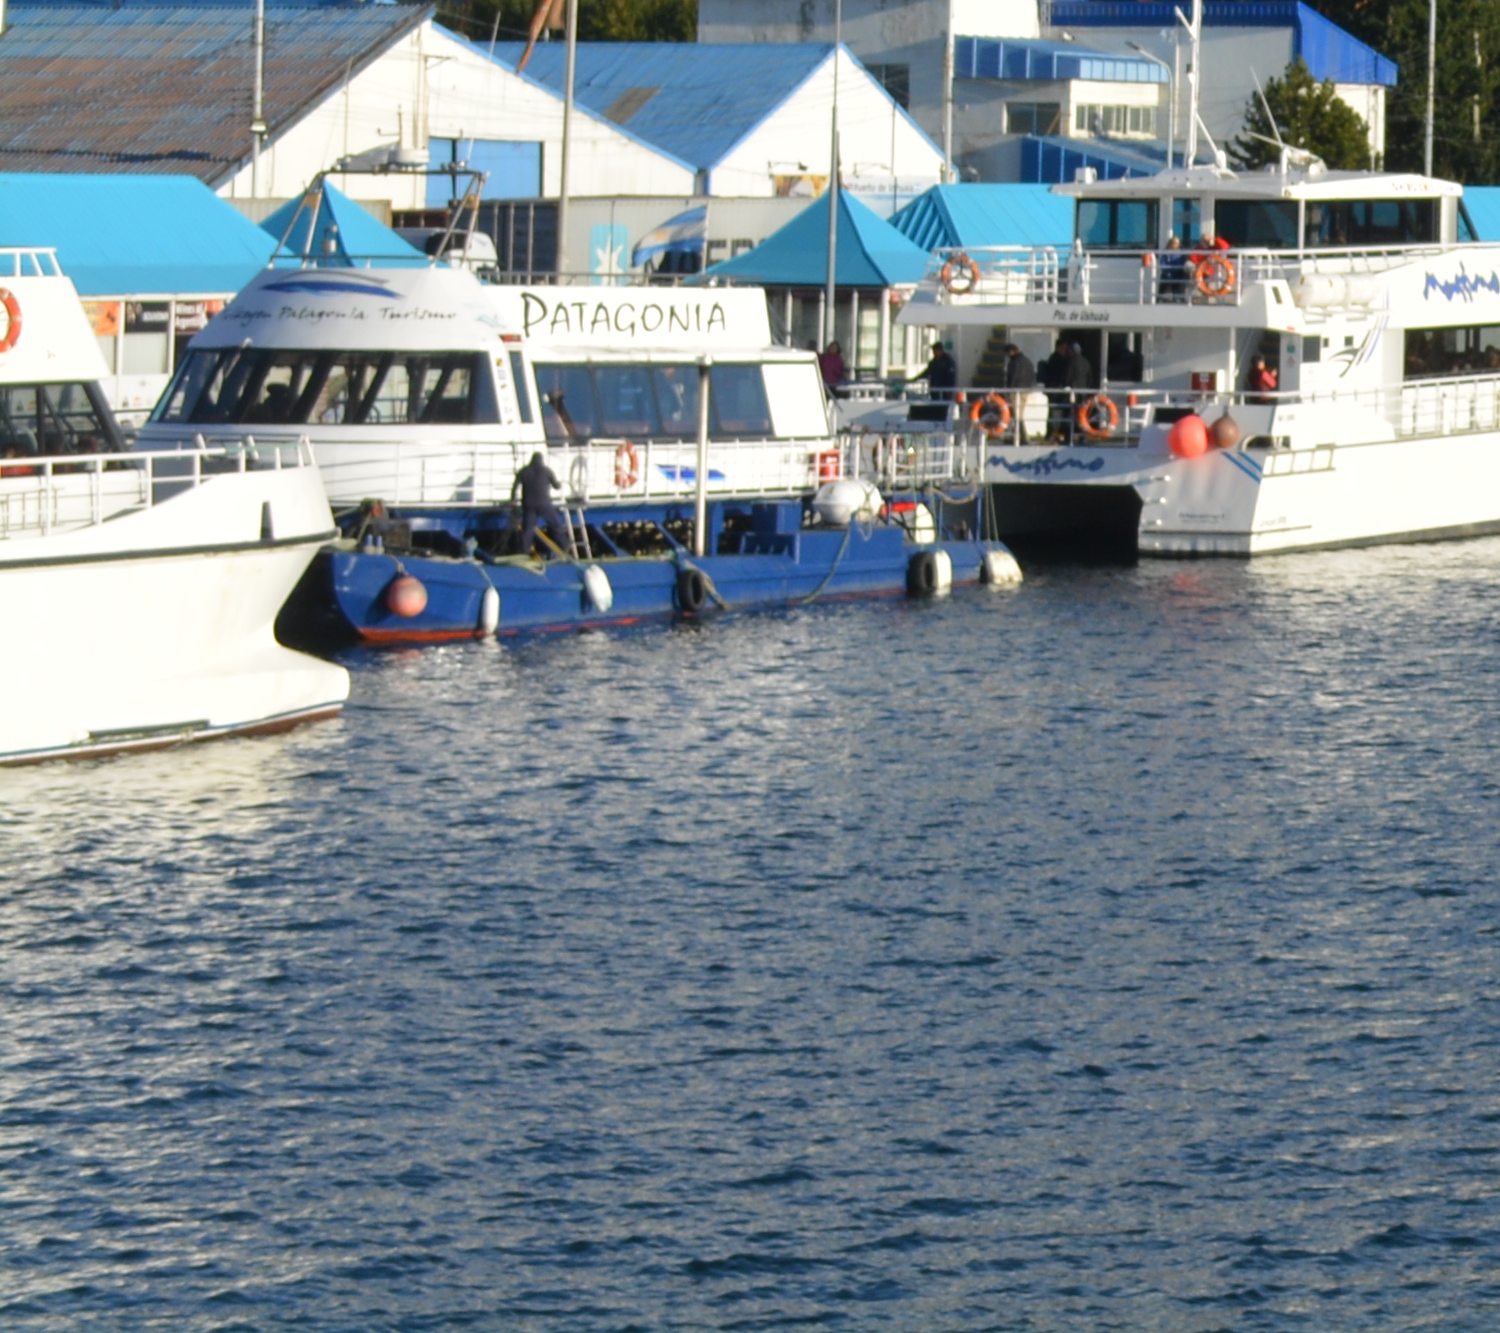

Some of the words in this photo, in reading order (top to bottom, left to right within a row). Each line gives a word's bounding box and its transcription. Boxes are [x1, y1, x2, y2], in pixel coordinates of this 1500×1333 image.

[278, 305, 368, 325] Patagonia
[379, 307, 457, 320] Turismo
[521, 291, 726, 338] PATAGONIA
